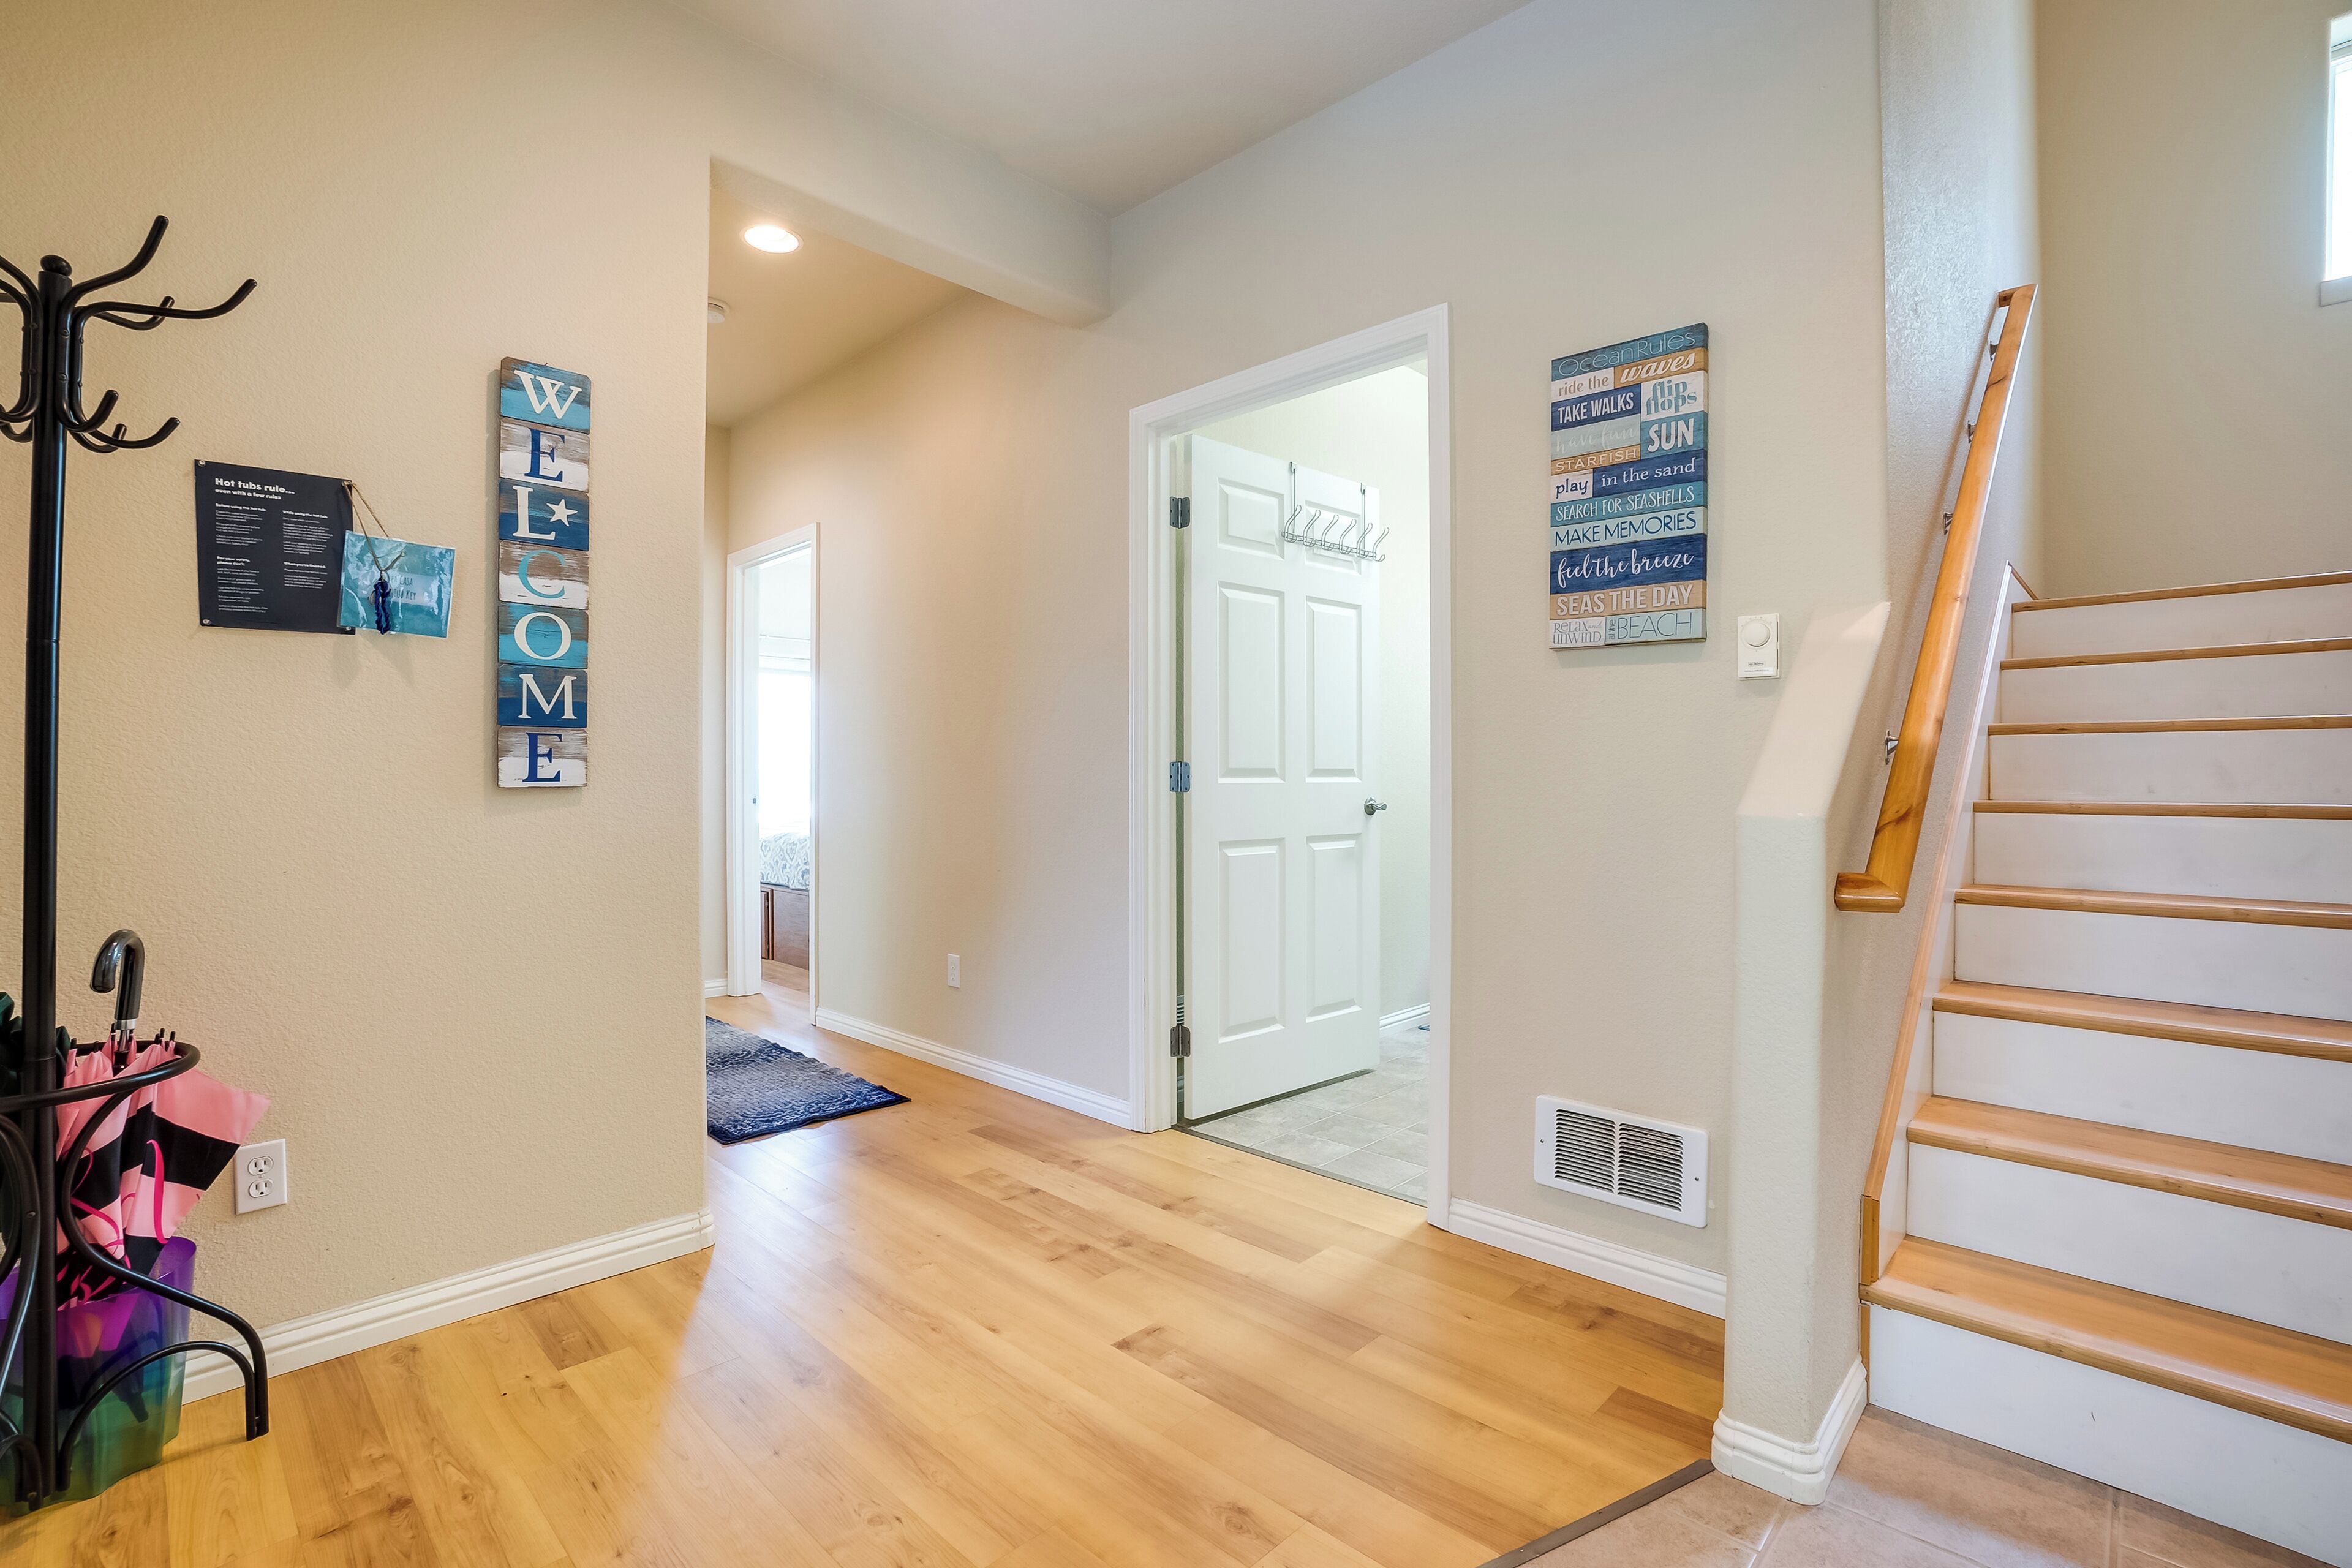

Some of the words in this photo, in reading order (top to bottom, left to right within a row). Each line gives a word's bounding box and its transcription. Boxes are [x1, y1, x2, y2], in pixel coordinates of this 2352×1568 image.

[1559, 347, 1633, 375] Ocean
[1637, 332, 1695, 357] Rules
[1620, 353, 1695, 383] waves
[1559, 380, 1583, 396] ride
[1588, 375, 1609, 390] the
[1652, 379, 1687, 402] flip
[1558, 402, 1588, 424] TAKE
[1591, 392, 1634, 417] WALKS
[1646, 392, 1697, 415] flops
[1556, 428, 1597, 453] have
[1602, 421, 1636, 450] fun
[1648, 418, 1694, 452] SUN
[1556, 448, 1637, 472] STARFISH
[1601, 474, 1618, 487] in
[1623, 468, 1649, 483] the
[1654, 457, 1696, 478] sand
[215, 478, 235, 487] Hot
[238, 481, 262, 490] tubs
[264, 485, 295, 494] rule...
[1556, 478, 1588, 499] play
[1556, 501, 1597, 521] SEARCH
[1602, 497, 1623, 516] FOR
[1626, 486, 1695, 511] SEASHELLS
[1555, 525, 1600, 546] MAKE
[1605, 511, 1696, 540] MEMORIES
[513, 369, 582, 782] WELCOME
[1558, 554, 1593, 588] feel
[1593, 556, 1629, 578] the
[1631, 548, 1695, 575] breeze
[1557, 594, 1605, 616] SEAS
[1608, 588, 1647, 611] THE
[1653, 584, 1694, 607] DAY
[1618, 612, 1692, 639] BEACH
